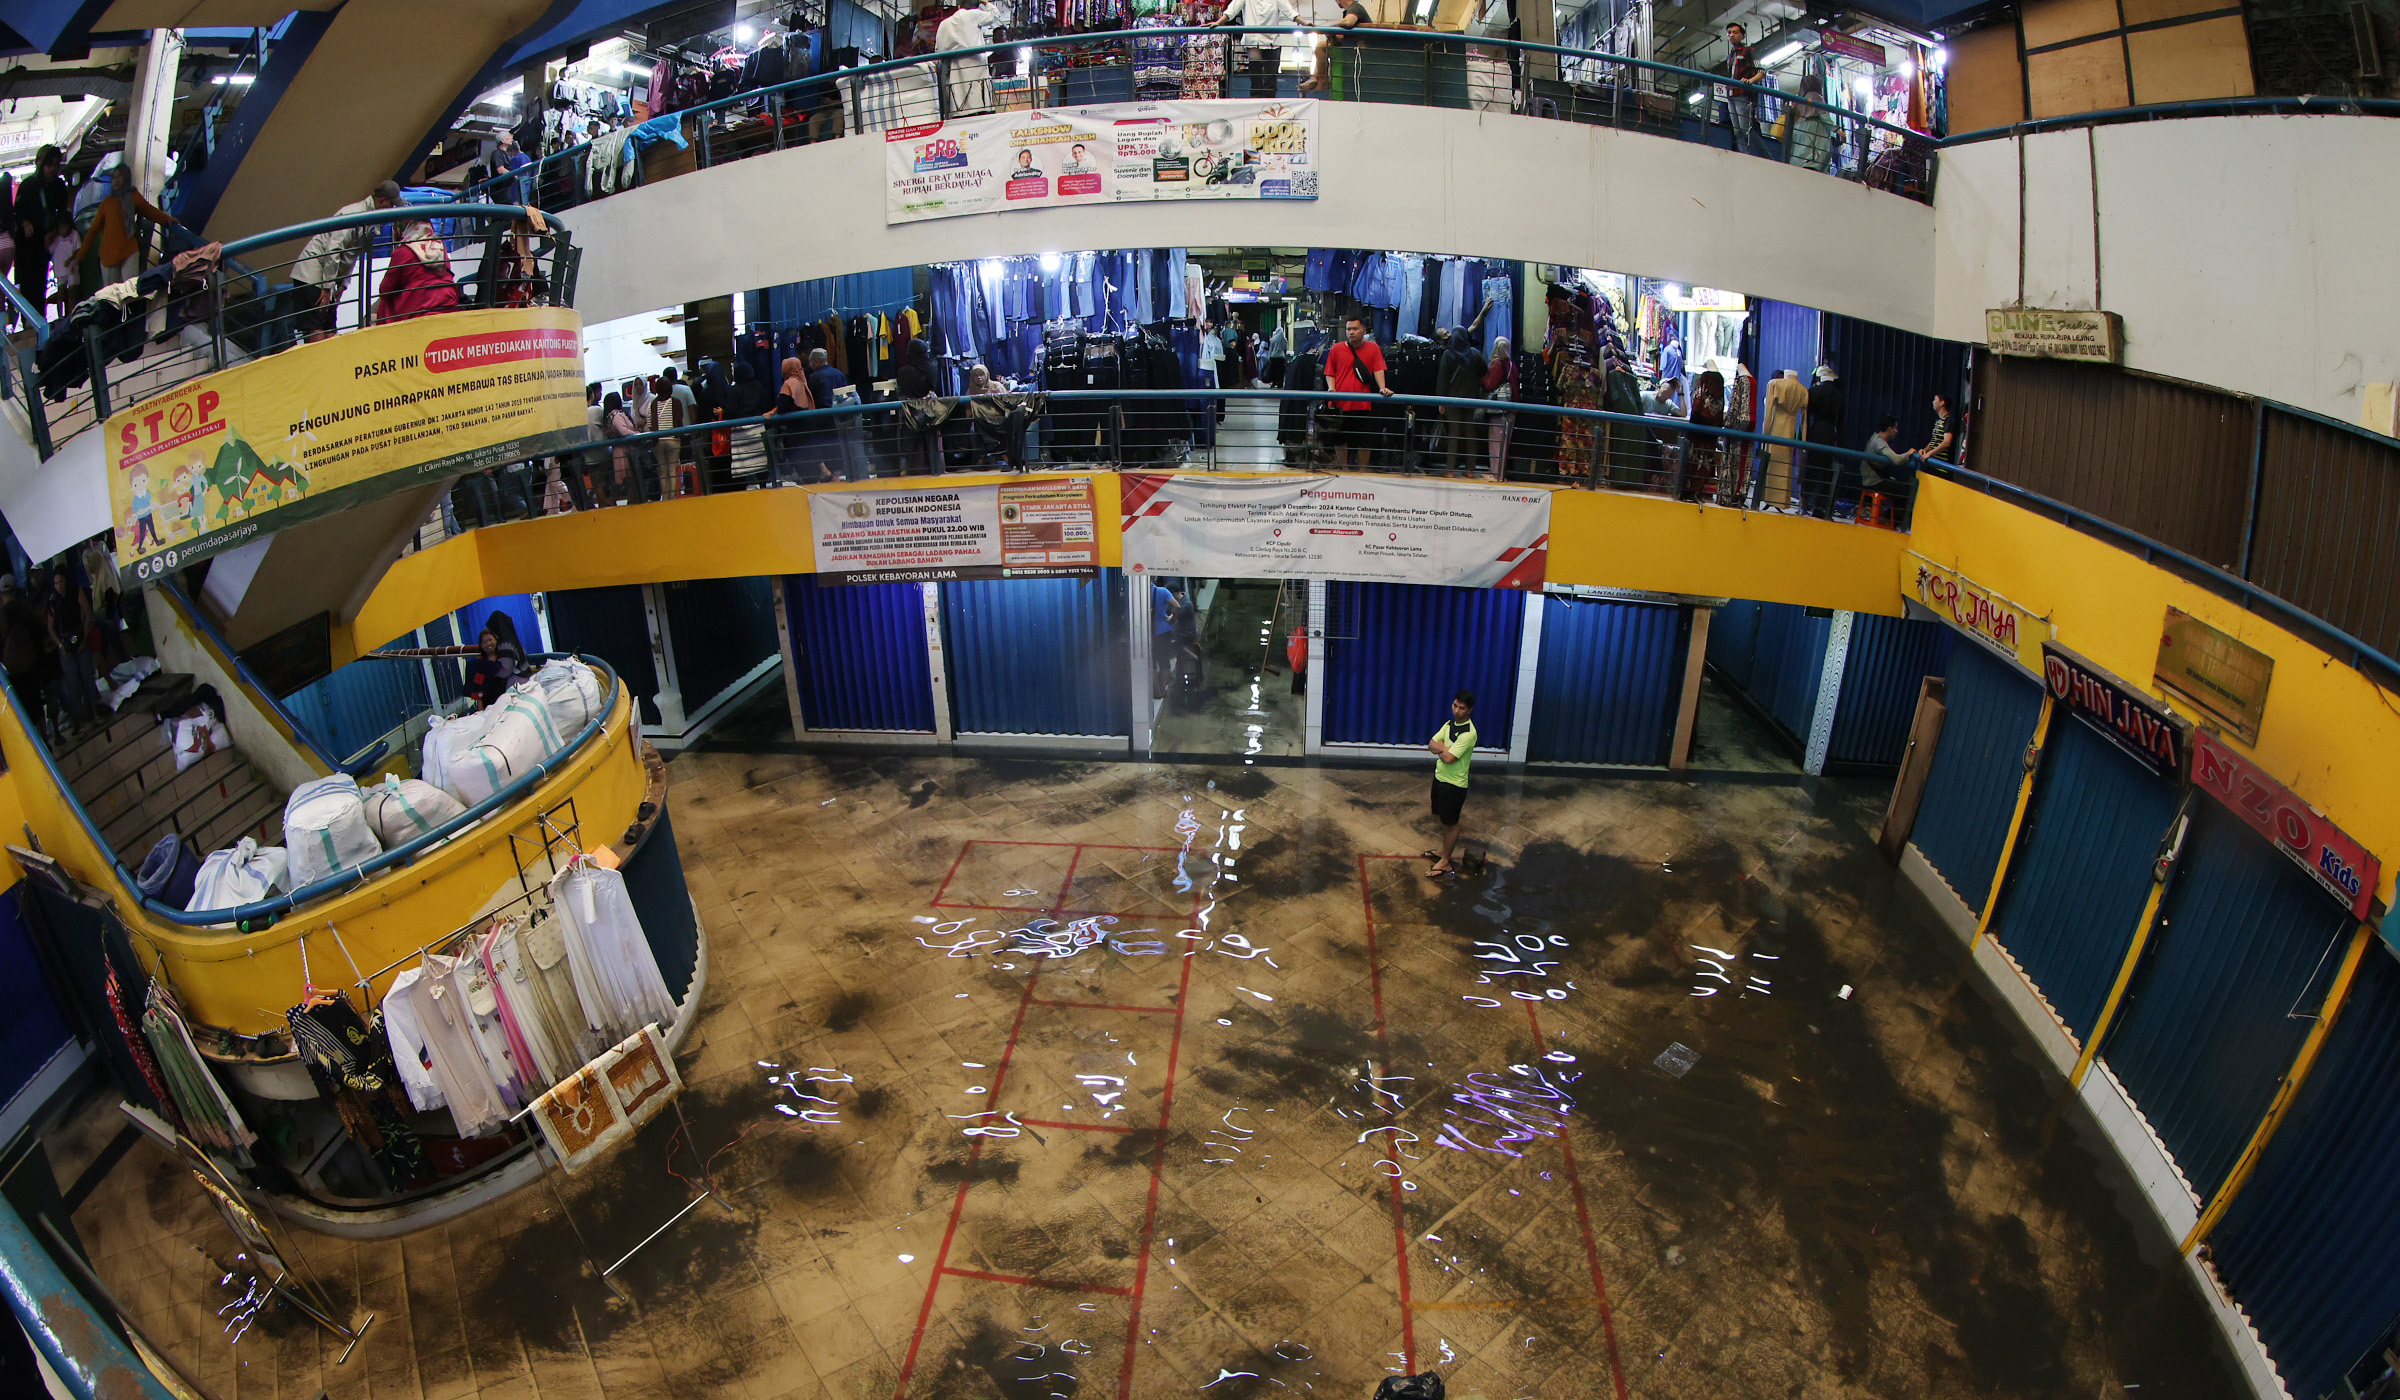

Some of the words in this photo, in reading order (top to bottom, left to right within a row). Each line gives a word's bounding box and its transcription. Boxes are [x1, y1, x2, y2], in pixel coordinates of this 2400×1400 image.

[1010, 124, 1072, 138] TALKSHOW
[1250, 122, 1306, 139] DOOR
[1009, 136, 1072, 147] DIMERIAHKAN
[1072, 133, 1096, 142] OLEH
[1250, 138, 1305, 154] PRIZE
[1117, 149, 1156, 157] Rp75.000
[892, 176, 926, 188] SINERGI
[928, 172, 953, 184] ERAT
[954, 168, 993, 181] MENJAGA
[902, 183, 933, 195] RUPIAH
[934, 178, 984, 192] BERDAULAT
[2057, 319, 2100, 331] Fashion
[2040, 333, 2071, 341] RUPA-RUPA
[2072, 334, 2095, 342] LEJING
[354, 359, 396, 380] PASAR
[401, 355, 419, 370] INI
[467, 339, 531, 358] MENYEDIAKAN
[533, 339, 561, 350] KANTONG
[132, 383, 202, 417] #SAATNYABERGERAK
[289, 403, 371, 436] PENGUNJUNG
[373, 386, 445, 412] DIHARAPKAN
[447, 377, 495, 396] MEMBAWA
[497, 374, 513, 386] TAS
[303, 437, 353, 458] BERDASARKAN
[354, 426, 392, 443] PERATURAN
[394, 417, 426, 433] GUBERNUR
[427, 415, 439, 425] DKI
[441, 409, 466, 421] JAKARTA
[466, 406, 484, 416] NOMOR
[484, 404, 494, 412] 142
[495, 401, 510, 411] TAHUN
[123, 447, 157, 467] PENGGUNAAN
[157, 439, 180, 452] PLASTIK
[180, 430, 201, 445] SEKALI
[202, 423, 221, 435] PAKAI
[304, 451, 350, 471] LINGKUNGAN
[351, 446, 370, 457] PADA
[371, 439, 392, 451] PUSAT
[393, 428, 444, 445] PERBELANJAAN,
[445, 423, 460, 433] TOKO
[501, 411, 516, 420] PASAR
[424, 460, 441, 472] Cikini
[441, 458, 456, 468] Raya
[474, 449, 492, 459] Jakarta
[492, 445, 505, 454] Pusat
[505, 441, 520, 450] 10330
[485, 456, 494, 464] 021
[875, 496, 924, 506] KEPOLISIAN
[924, 493, 960, 503] NEGARA
[1300, 488, 1375, 500] Pengumuman
[876, 506, 914, 516] REPUBLIK
[915, 503, 962, 513] INDONESIA
[1429, 509, 1448, 517] Cipulir
[841, 518, 874, 529] Himbauan
[875, 518, 895, 527] Untuk
[896, 517, 919, 526] Semua
[920, 514, 962, 526] Masyarakat
[1451, 525, 1479, 533] Dilakukan
[838, 531, 866, 539] SAYANG
[867, 529, 886, 537] ANAK
[886, 527, 921, 536] PASTIKAN
[922, 526, 946, 534] PUKUL
[946, 525, 968, 533] 22.00
[181, 523, 258, 560] perumdapasarjaya
[858, 552, 896, 560] RAMADHAN
[896, 550, 925, 558] SEBAGAI
[846, 573, 878, 583] POLSEK
[879, 571, 930, 581] KEBAYORAN
[932, 570, 958, 579] LAMA
[1931, 575, 1963, 624] CR
[1966, 591, 2018, 646] JAYA
[2070, 668, 2113, 723] HIN
[2116, 699, 2177, 767] JAYA
[2318, 844, 2360, 896] Kids
